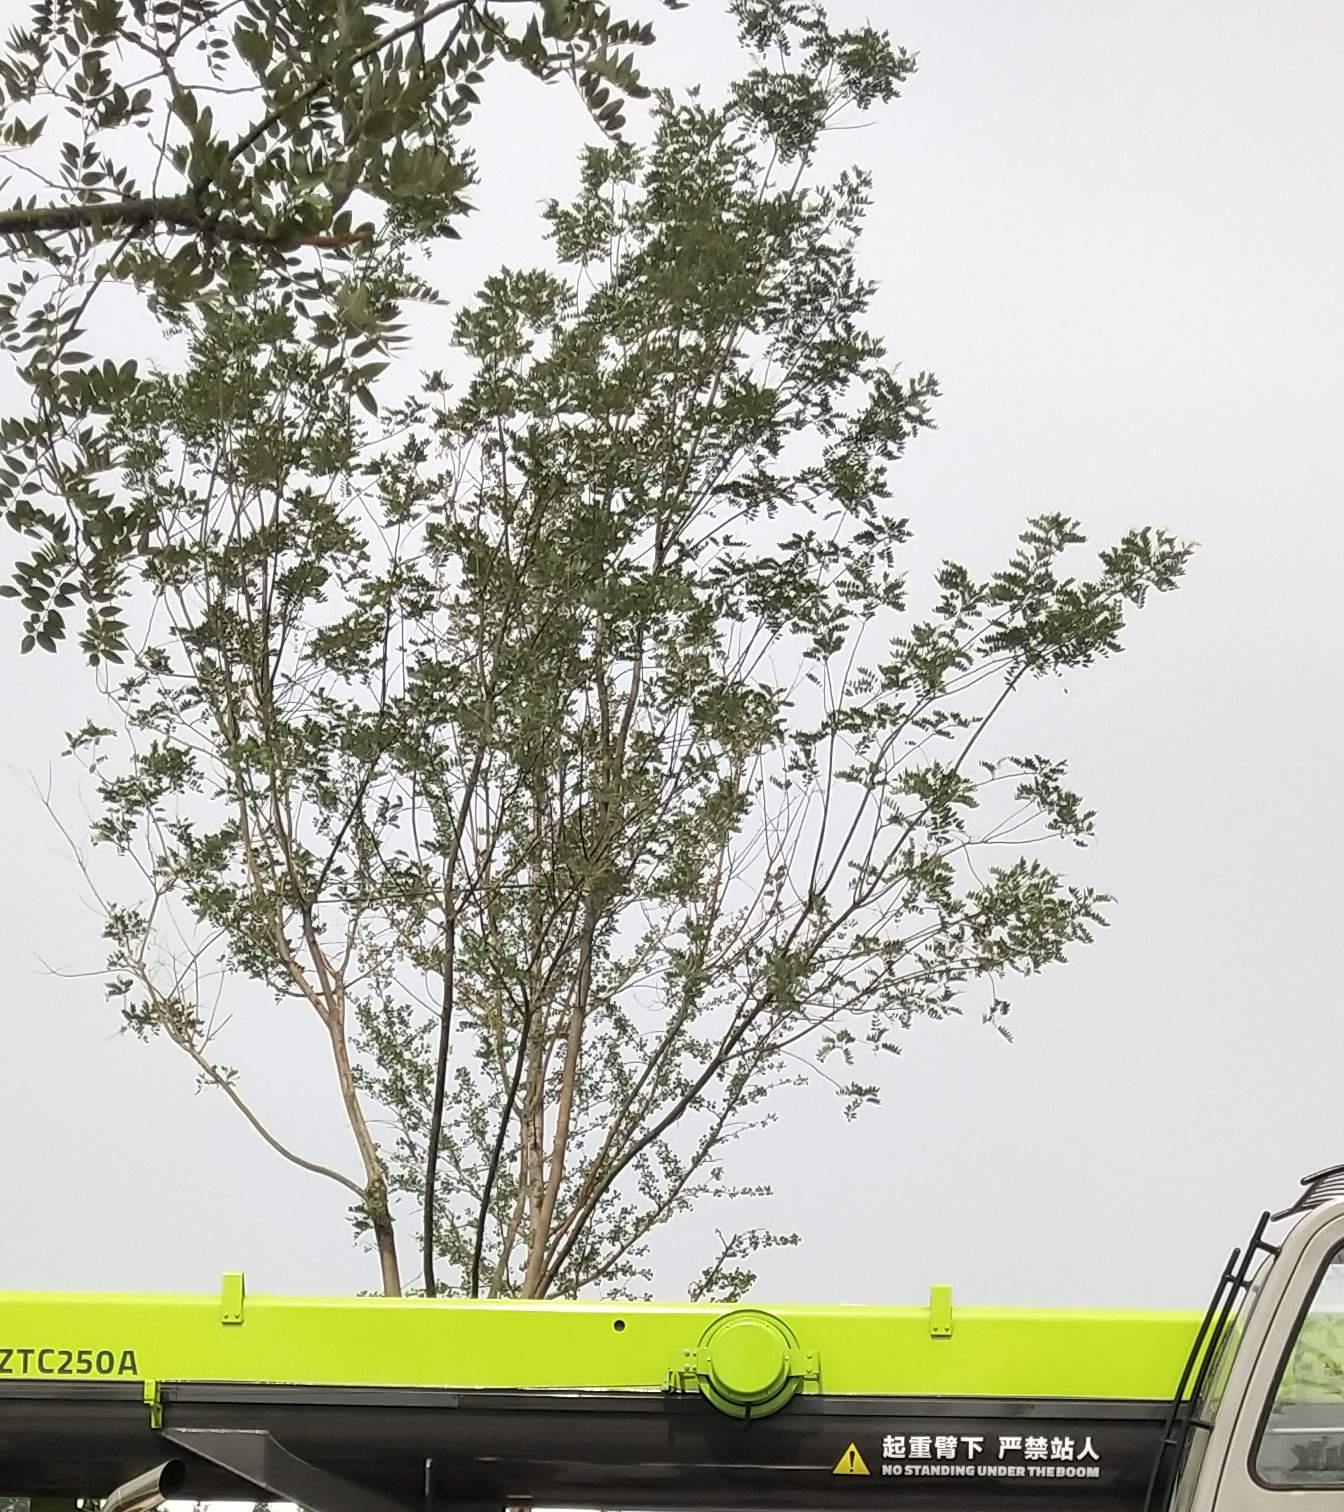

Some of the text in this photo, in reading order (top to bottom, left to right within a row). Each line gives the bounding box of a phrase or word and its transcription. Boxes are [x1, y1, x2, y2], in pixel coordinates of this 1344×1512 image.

[882, 1435, 1100, 1461] 起重臂下 严禁站人
[881, 1465, 1100, 1478] NO STANDING UNDER THE BOOM
